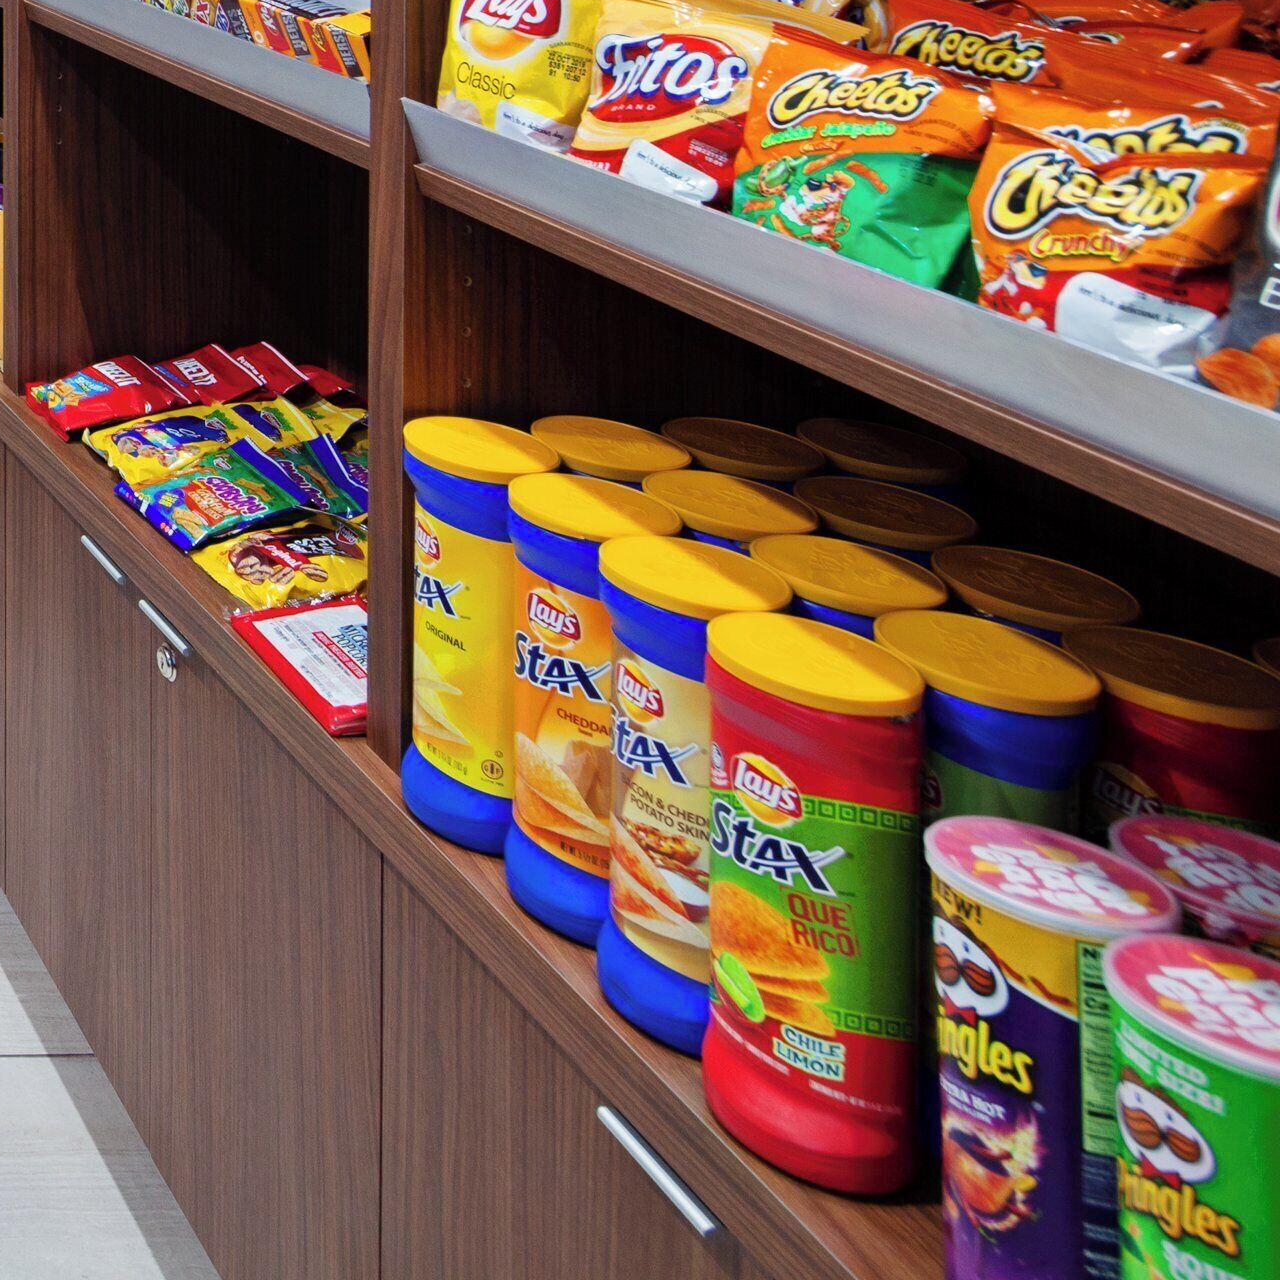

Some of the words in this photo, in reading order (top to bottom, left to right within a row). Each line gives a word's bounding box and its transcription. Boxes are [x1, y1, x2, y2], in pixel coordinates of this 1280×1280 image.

[893, 24, 1043, 80] Cheetos
[457, 61, 516, 100] Classic
[589, 33, 748, 112] Fritos
[610, 103, 657, 112] BRAND
[771, 70, 932, 126] Cheetos
[528, 591, 578, 635] Lay's
[425, 621, 467, 652] ORIGINAL
[617, 664, 662, 714] Lay's
[654, 796, 664, 808] &
[732, 760, 800, 817] Lay's
[630, 797, 675, 827] POTATO
[787, 893, 850, 933] QUE
[790, 917, 856, 957] RICO
[784, 1023, 845, 1058] CHILE
